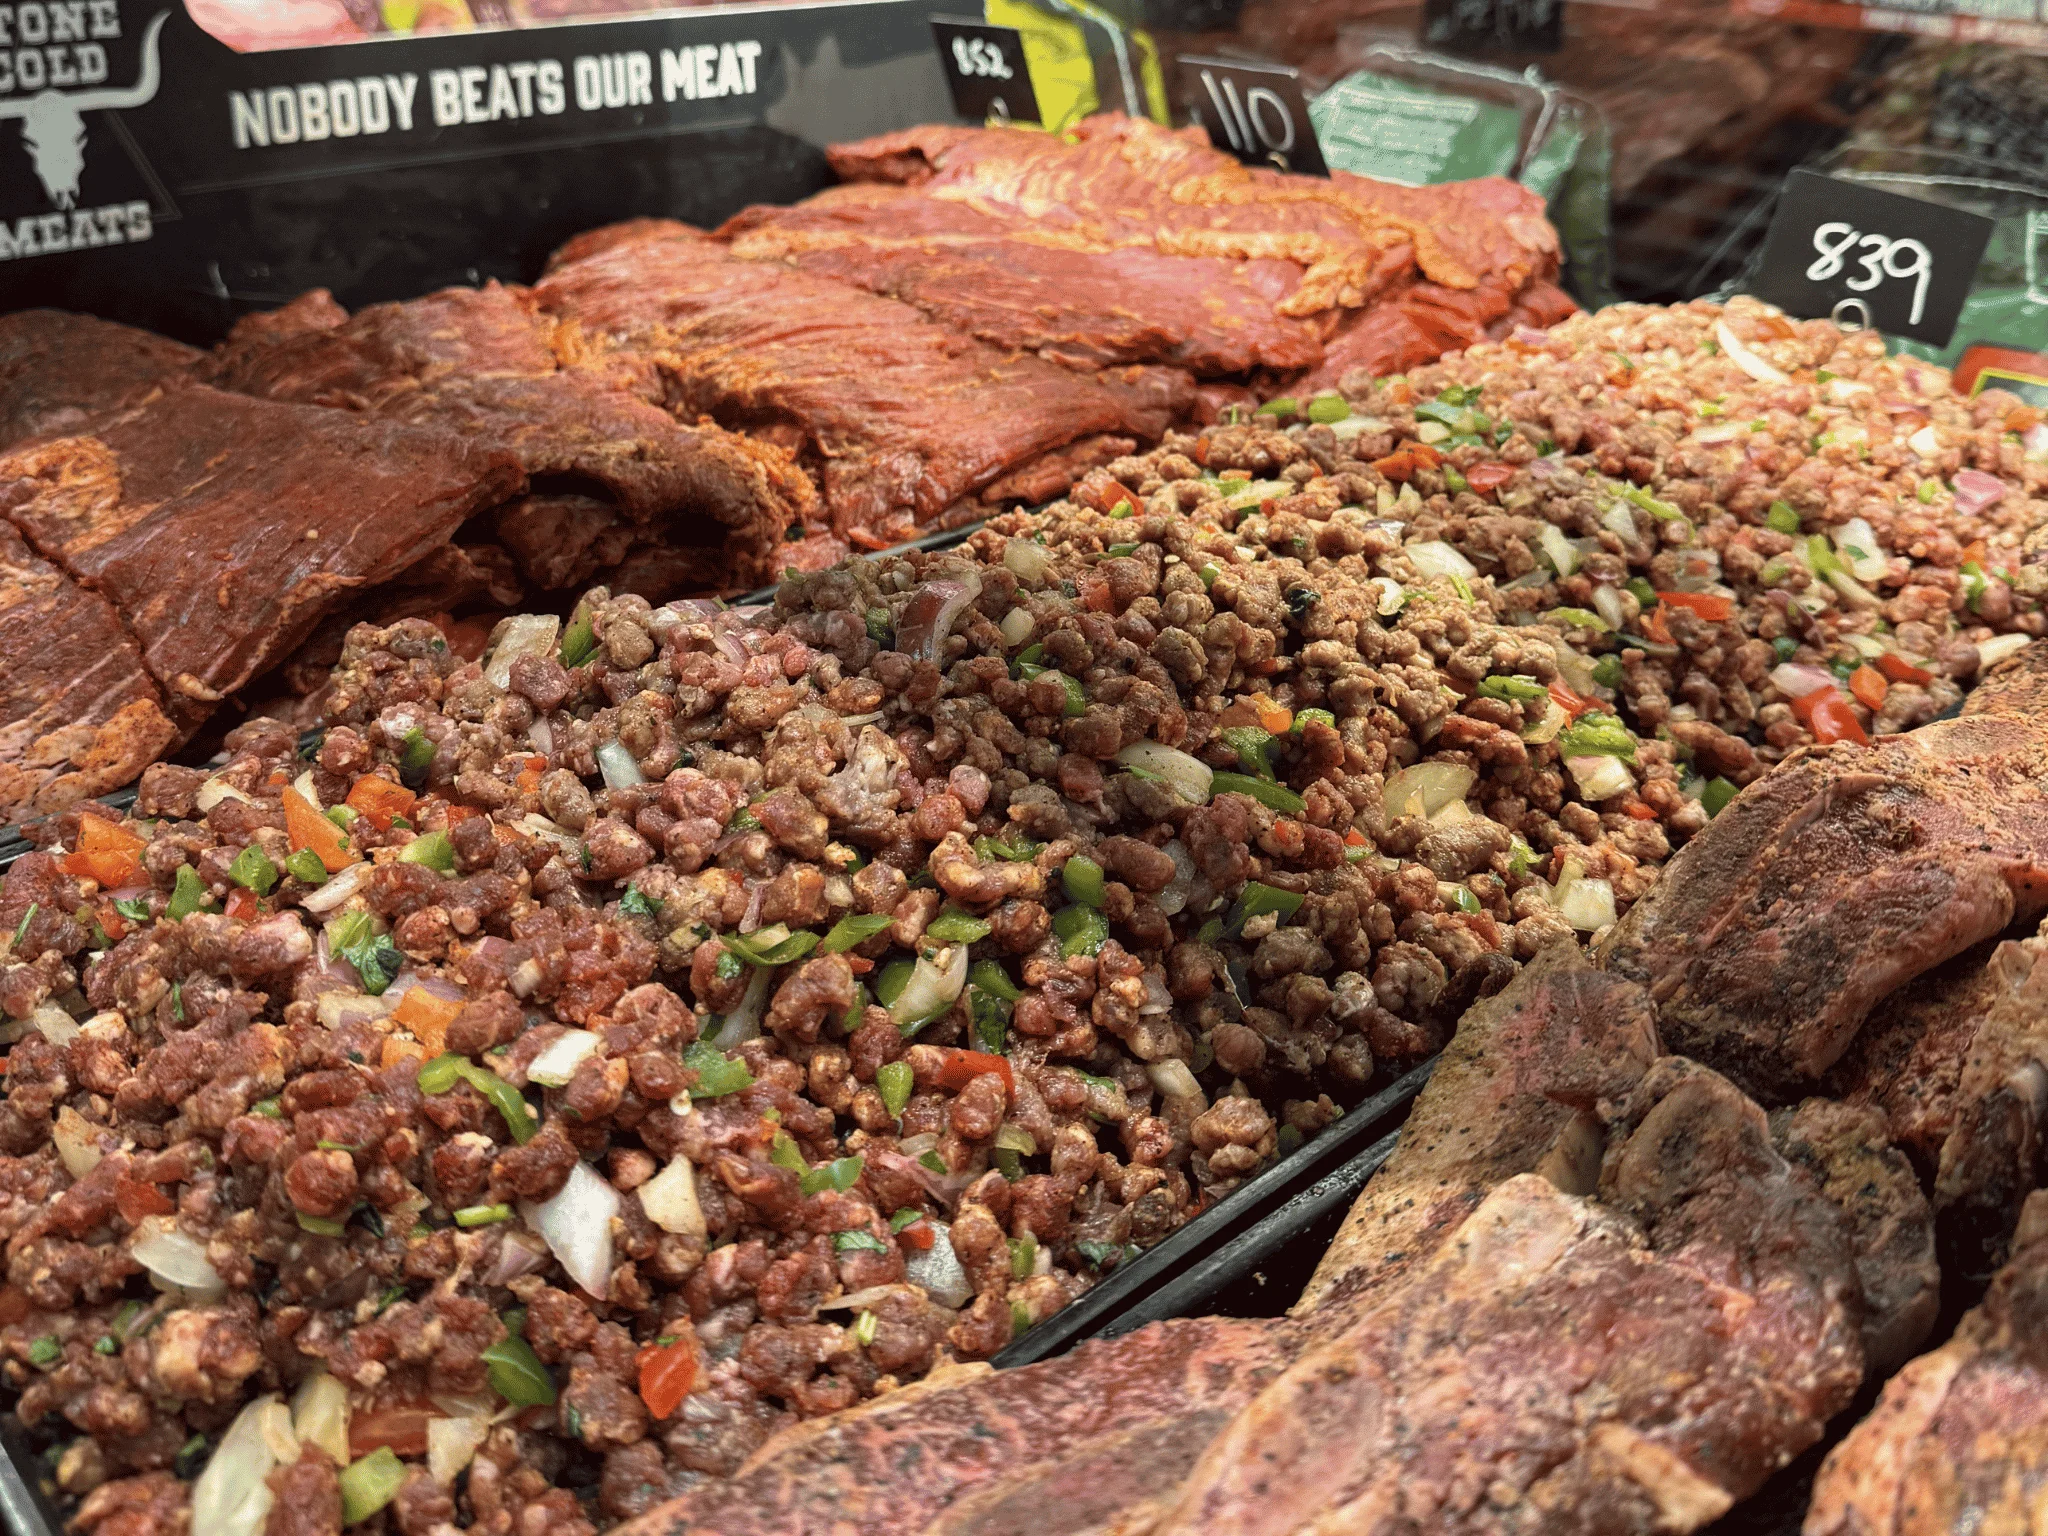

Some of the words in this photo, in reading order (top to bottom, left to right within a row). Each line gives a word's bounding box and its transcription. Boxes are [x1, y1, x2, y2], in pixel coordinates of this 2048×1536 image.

[229, 73, 418, 149] NOBODY
[429, 59, 565, 127] BEATS
[573, 52, 653, 111] OUR
[659, 40, 762, 102] MEAT
[1201, 69, 1295, 153] 110
[0, 200, 152, 261] MEATS
[1806, 222, 1932, 325] 839
